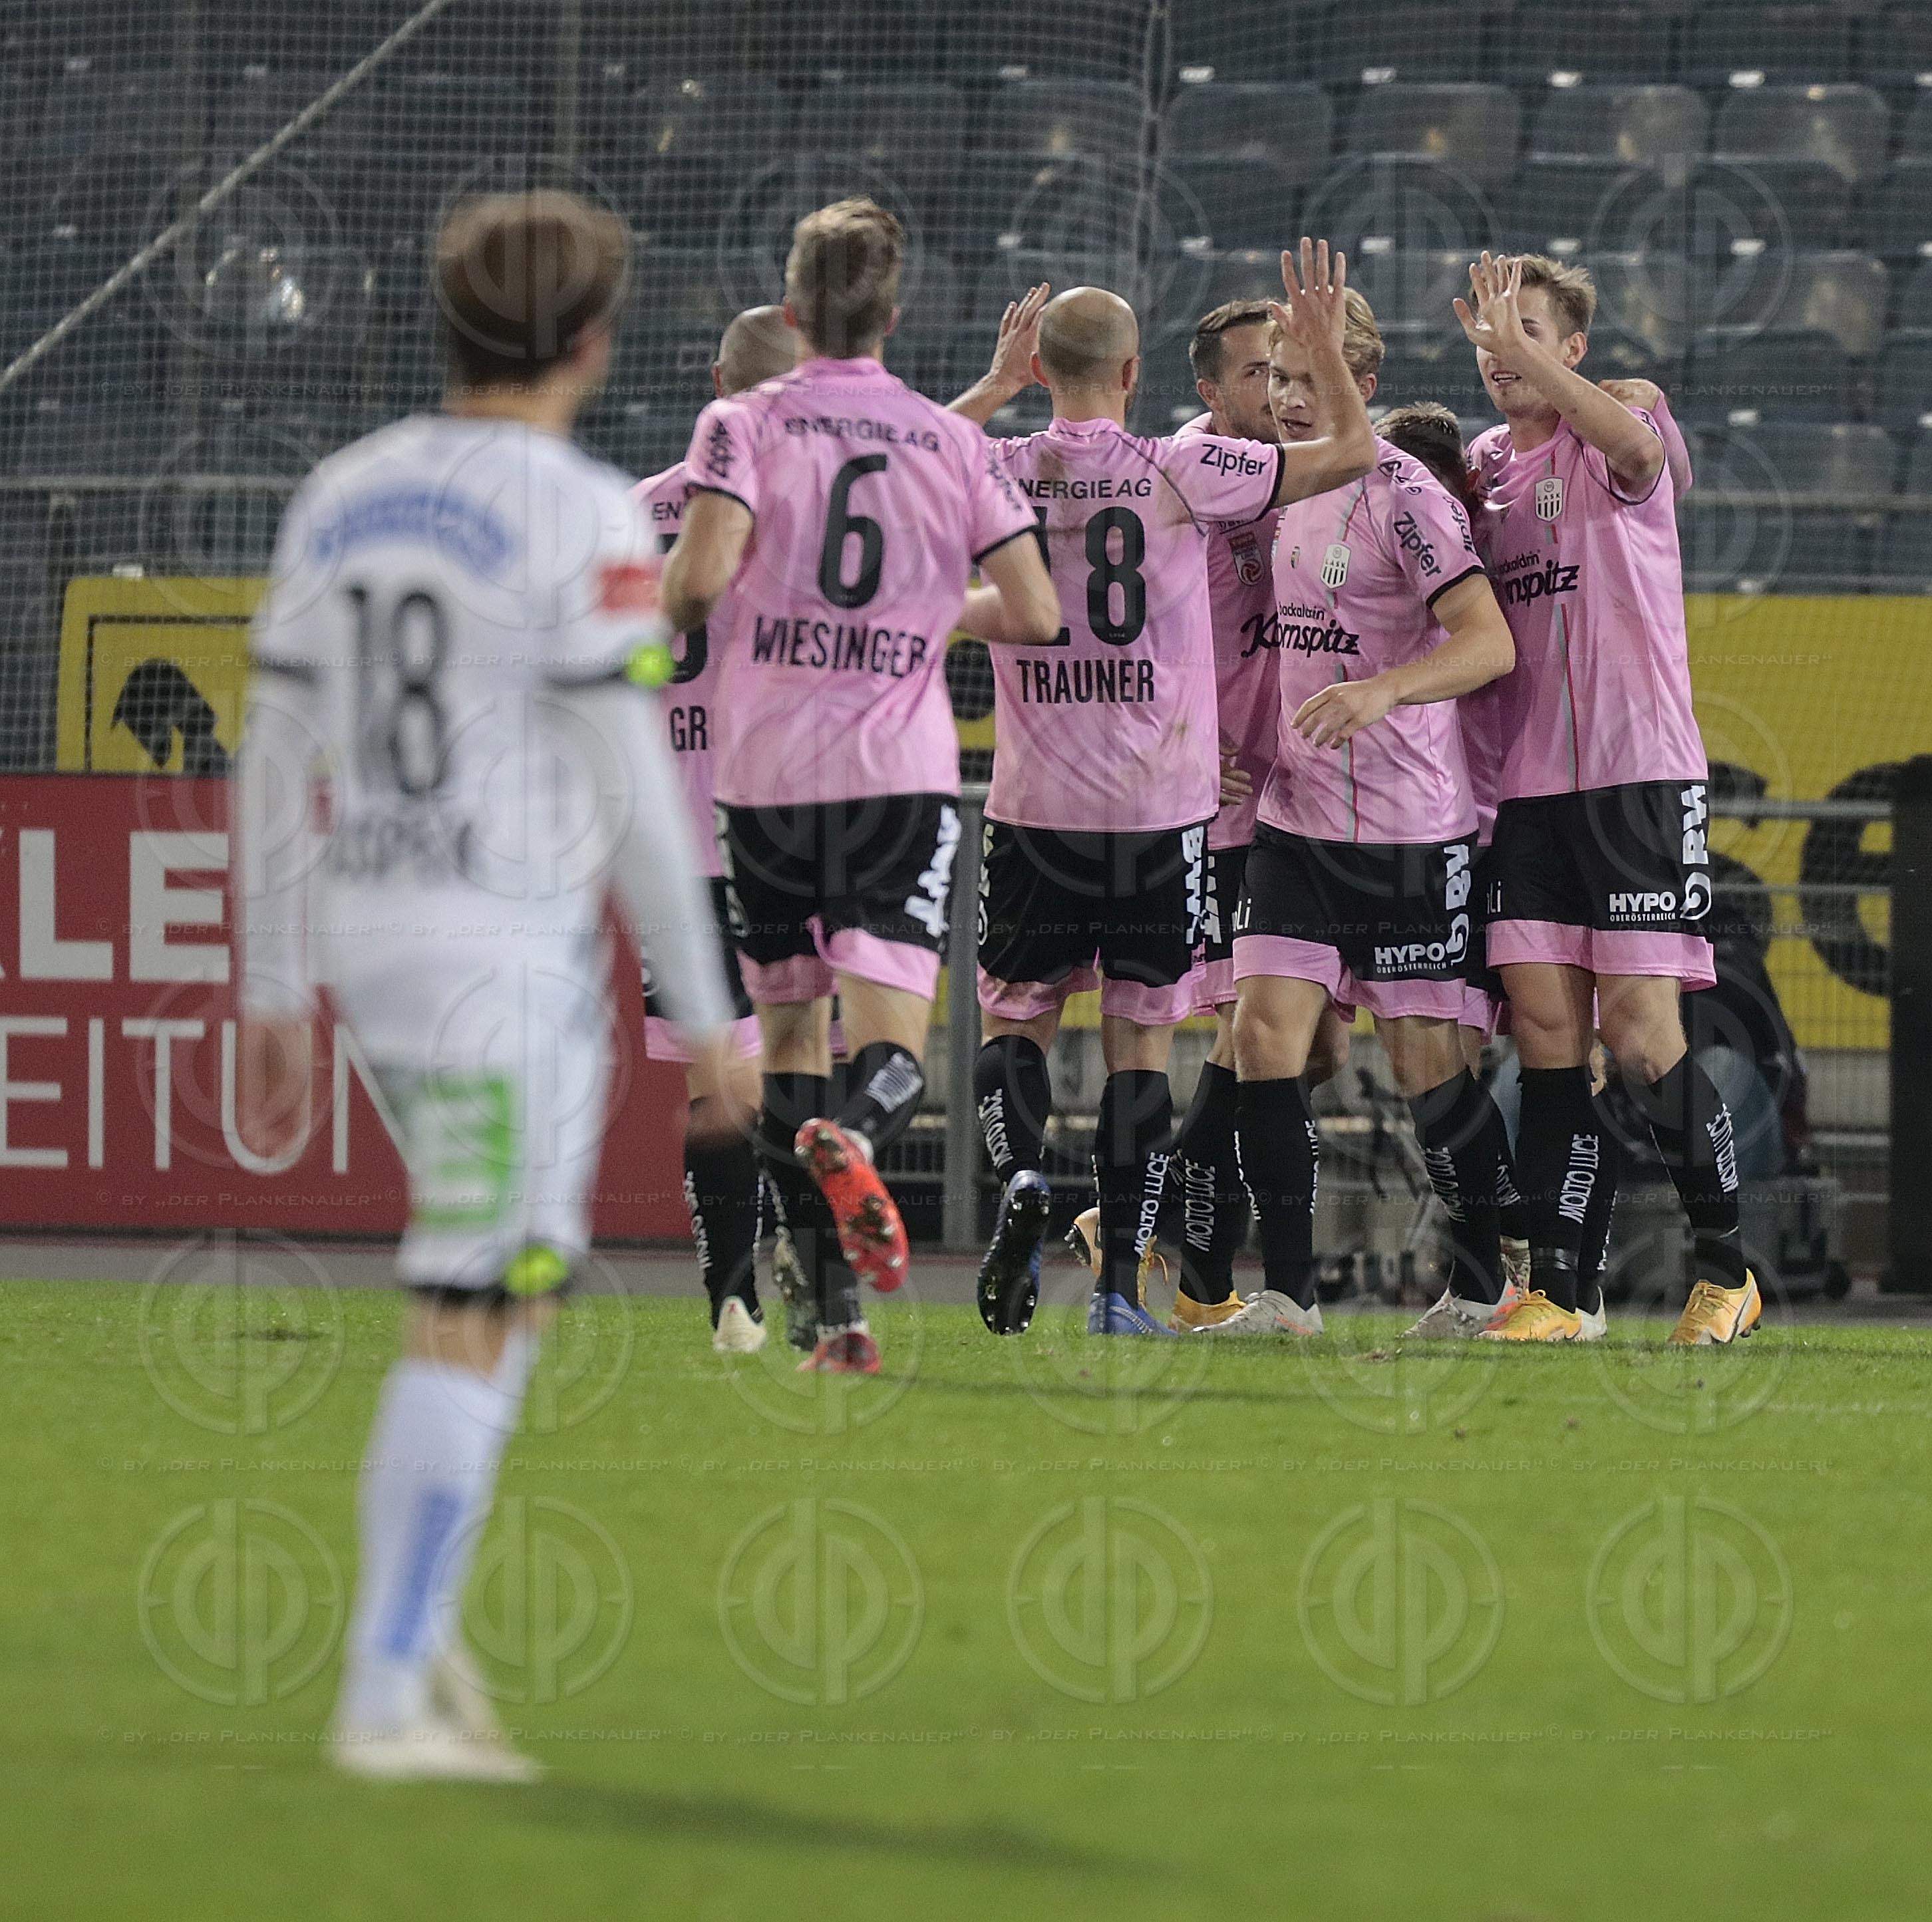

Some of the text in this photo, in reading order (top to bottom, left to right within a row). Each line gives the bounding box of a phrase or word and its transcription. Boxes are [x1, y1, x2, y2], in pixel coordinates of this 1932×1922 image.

[1200, 443, 1267, 476] Zipfer
[653, 501, 683, 520] EN
[1019, 478, 1113, 499] NERGIE
[1537, 493, 1560, 502] LASK
[817, 454, 887, 608] 6
[1394, 511, 1442, 577] Zipfer
[753, 616, 927, 677] WIESINGER
[347, 581, 450, 796] 18
[1017, 659, 1154, 703] TRAUNER
[669, 705, 708, 752] GR
[0, 829, 231, 983] LE
[1609, 891, 1677, 912] HYPO
[1374, 942, 1446, 965] HYPO
[0, 1016, 410, 1176] EITUN
[1134, 1151, 1170, 1258] MOLTO LUCE
[1557, 1133, 1599, 1224] MOLTO LUCE
